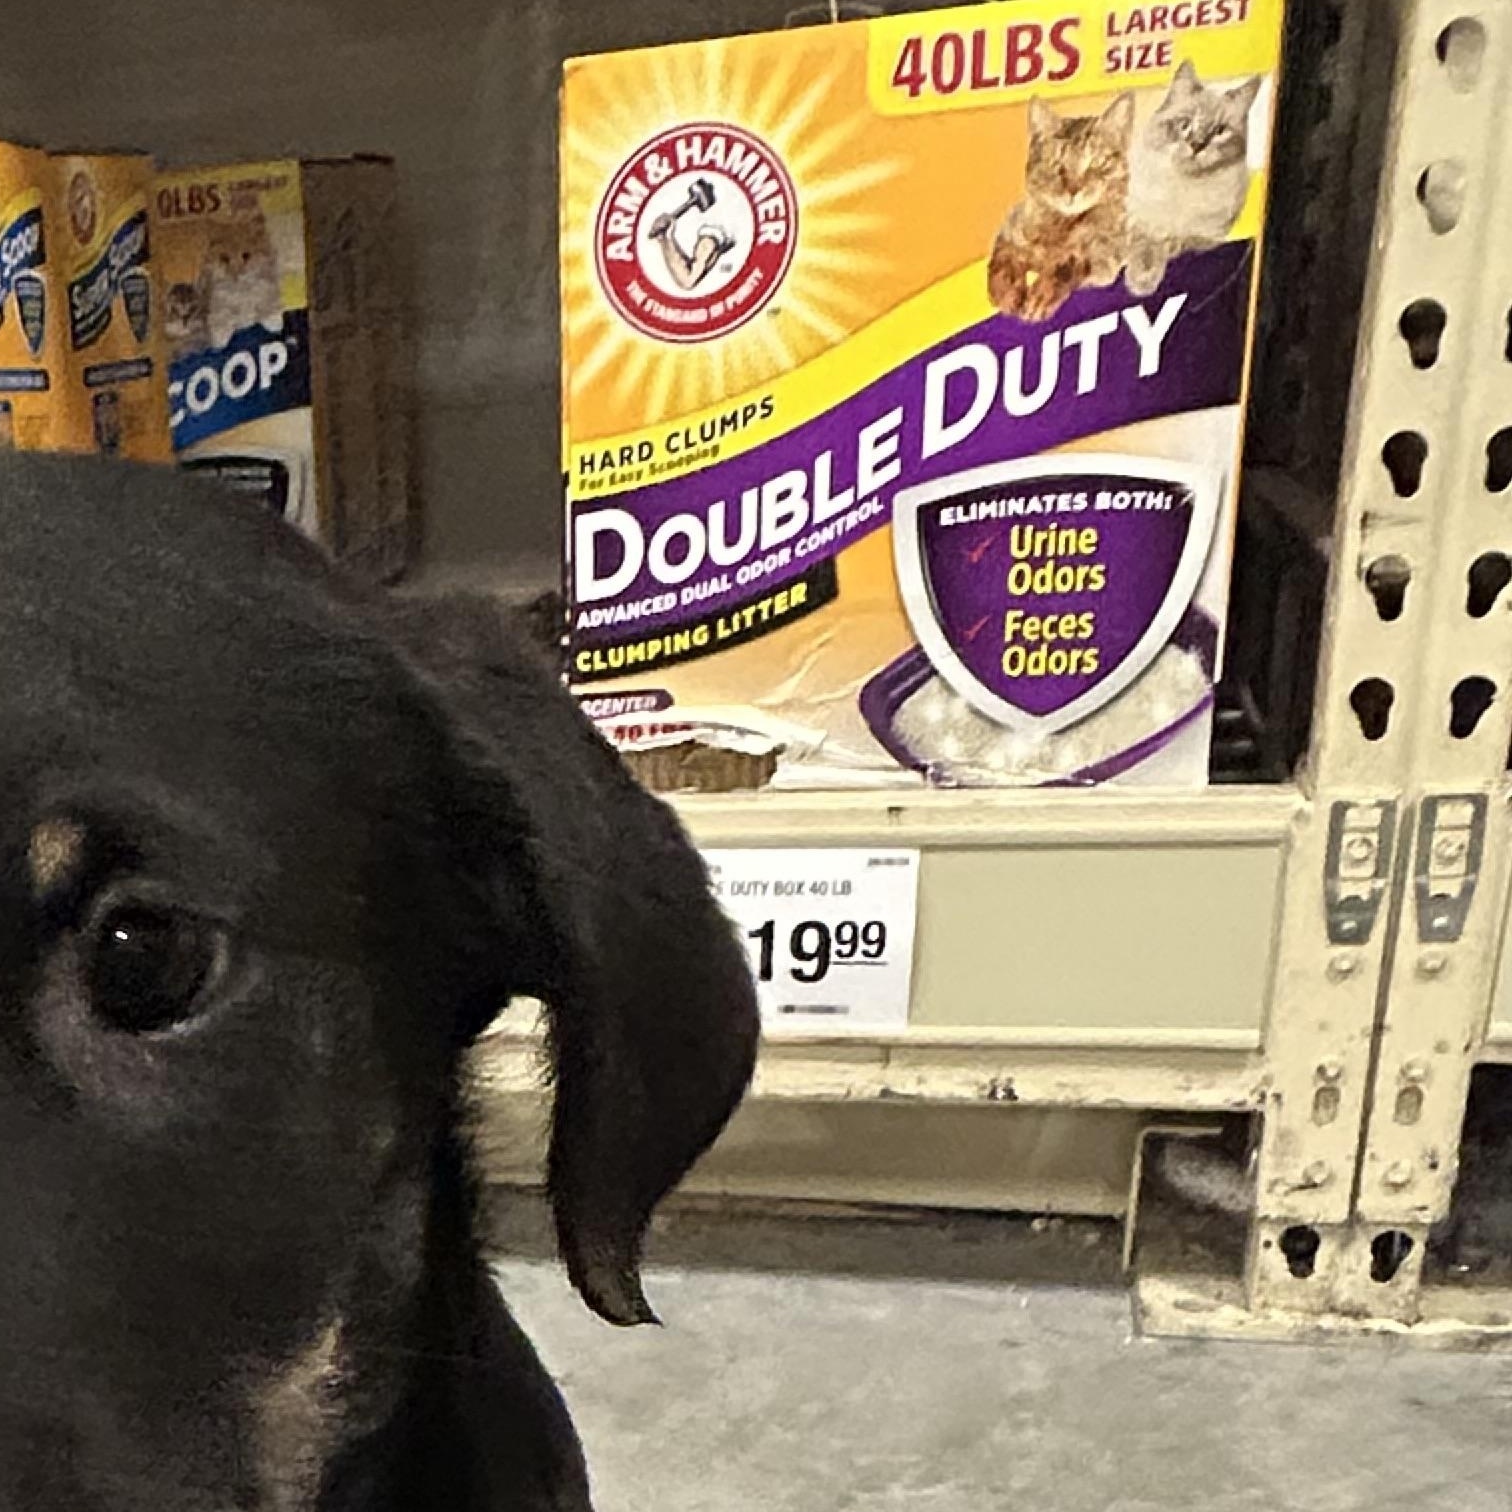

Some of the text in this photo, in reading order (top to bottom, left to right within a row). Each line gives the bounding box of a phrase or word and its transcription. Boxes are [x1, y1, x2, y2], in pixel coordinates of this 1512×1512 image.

[892, 0, 1250, 98] 40LBS LARGEST
[1105, 40, 1173, 73] SIZE
[607, 134, 786, 262] ARM & HAMMER
[575, 294, 1187, 604] DOUBLE DUTY
[579, 395, 775, 475] HARD CLUMPS
[940, 492, 1087, 526] ELIMINATES
[1010, 522, 1098, 559] Urine
[577, 496, 885, 630] ADVANCED DUAL ODOR CONTROL
[1007, 561, 1106, 596] Odors
[575, 582, 808, 673] CLUMPING LITTER
[1004, 609, 1095, 643] Feces
[1002, 644, 1100, 678] Odors
[730, 880, 770, 896] DUTY
[773, 880, 806, 896] BOX
[808, 880, 829, 895] 40
[832, 879, 853, 896] LB
